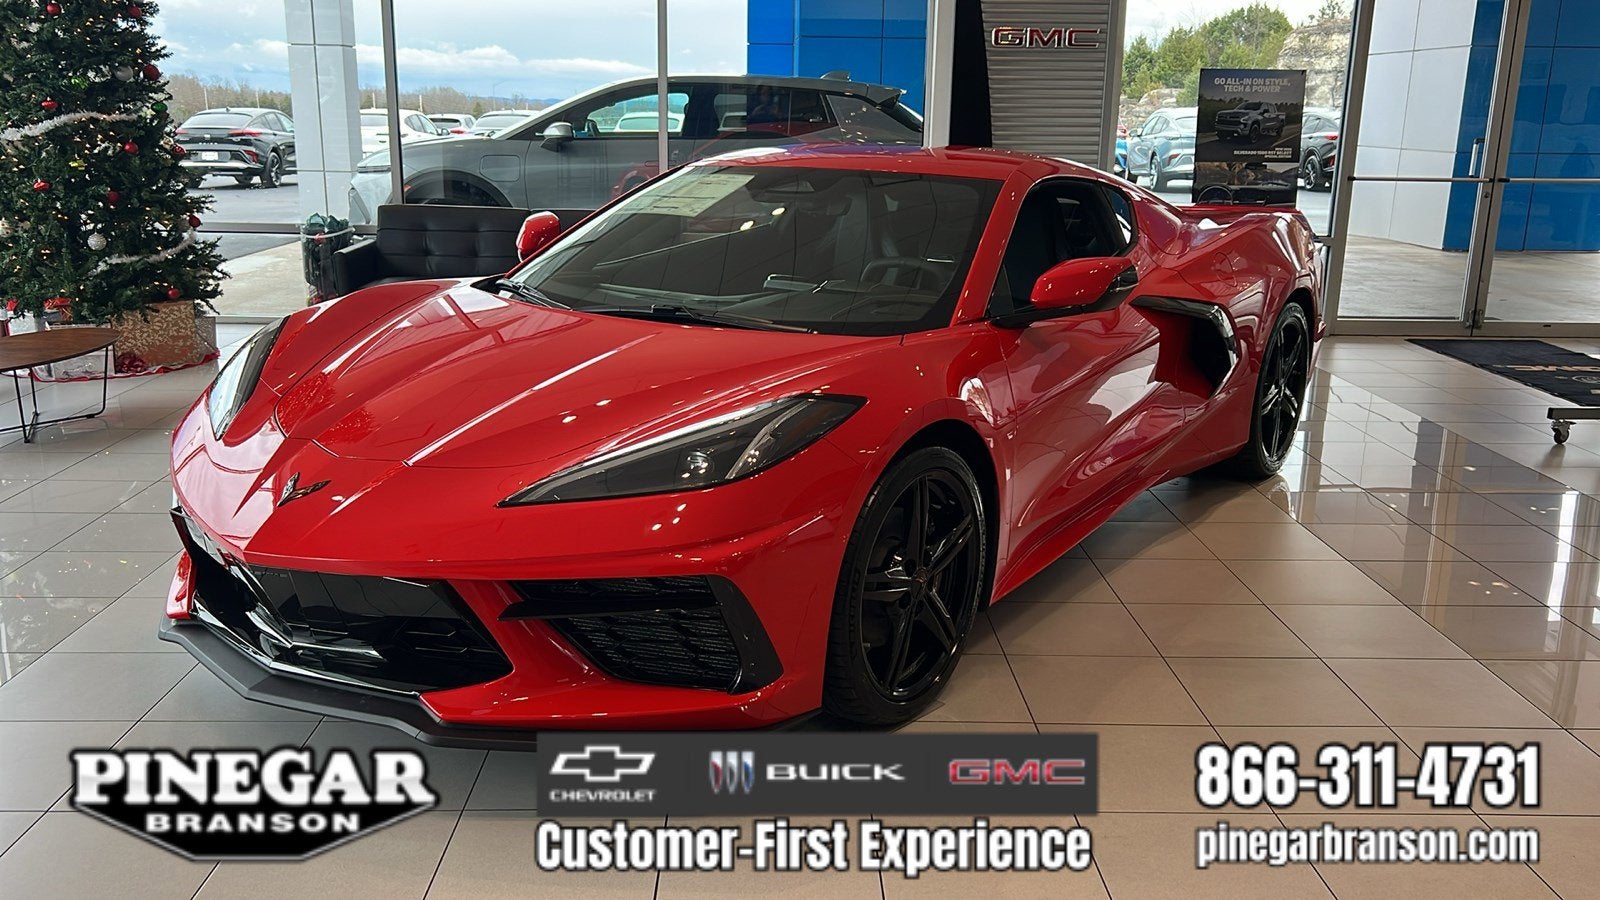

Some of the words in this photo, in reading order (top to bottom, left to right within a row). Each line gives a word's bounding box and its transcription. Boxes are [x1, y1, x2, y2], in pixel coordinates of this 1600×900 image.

[991, 27, 1100, 48] GMC
[1214, 77, 1226, 85] GO
[1226, 77, 1252, 85] ALL-IN
[1252, 78, 1264, 86] ON
[1265, 78, 1291, 87] STYLE,
[1252, 85, 1280, 93] POWER
